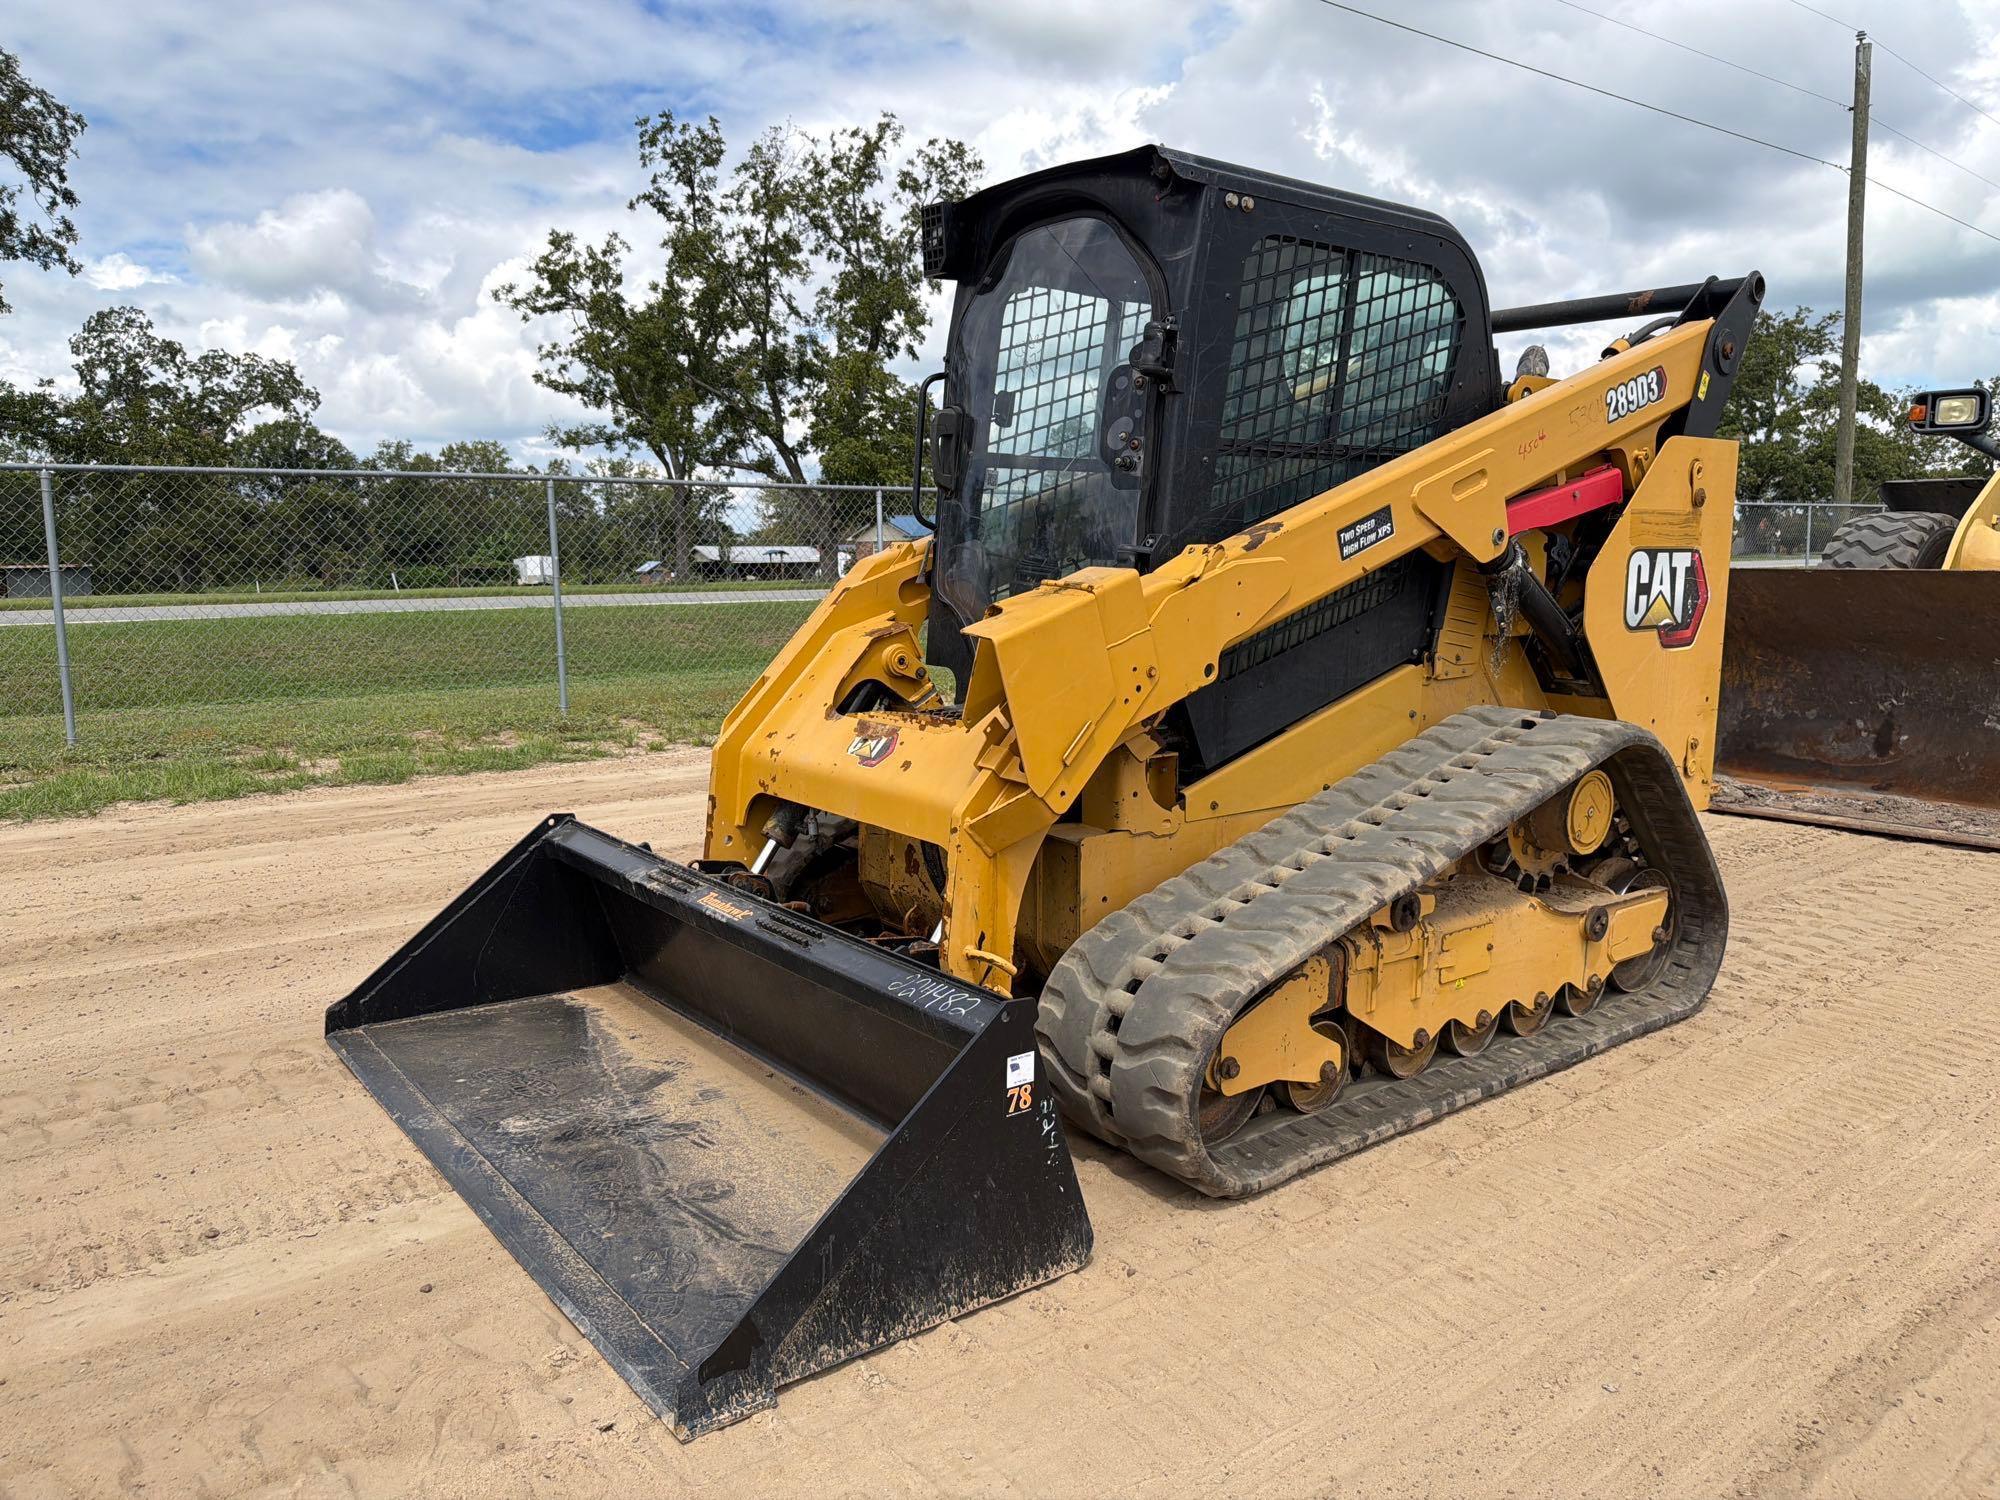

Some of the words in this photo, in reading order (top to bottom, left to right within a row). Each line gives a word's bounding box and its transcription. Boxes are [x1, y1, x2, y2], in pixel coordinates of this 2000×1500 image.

[1605, 370, 1659, 423] 289D3
[1340, 529, 1355, 544] TWO
[1355, 518, 1376, 536] SPEED
[1343, 541, 1359, 557] HIGH
[1359, 531, 1377, 549] FLOW
[1377, 522, 1392, 539] XPS
[1625, 550, 1692, 628] CAT
[1006, 1083, 1032, 1113] 78
